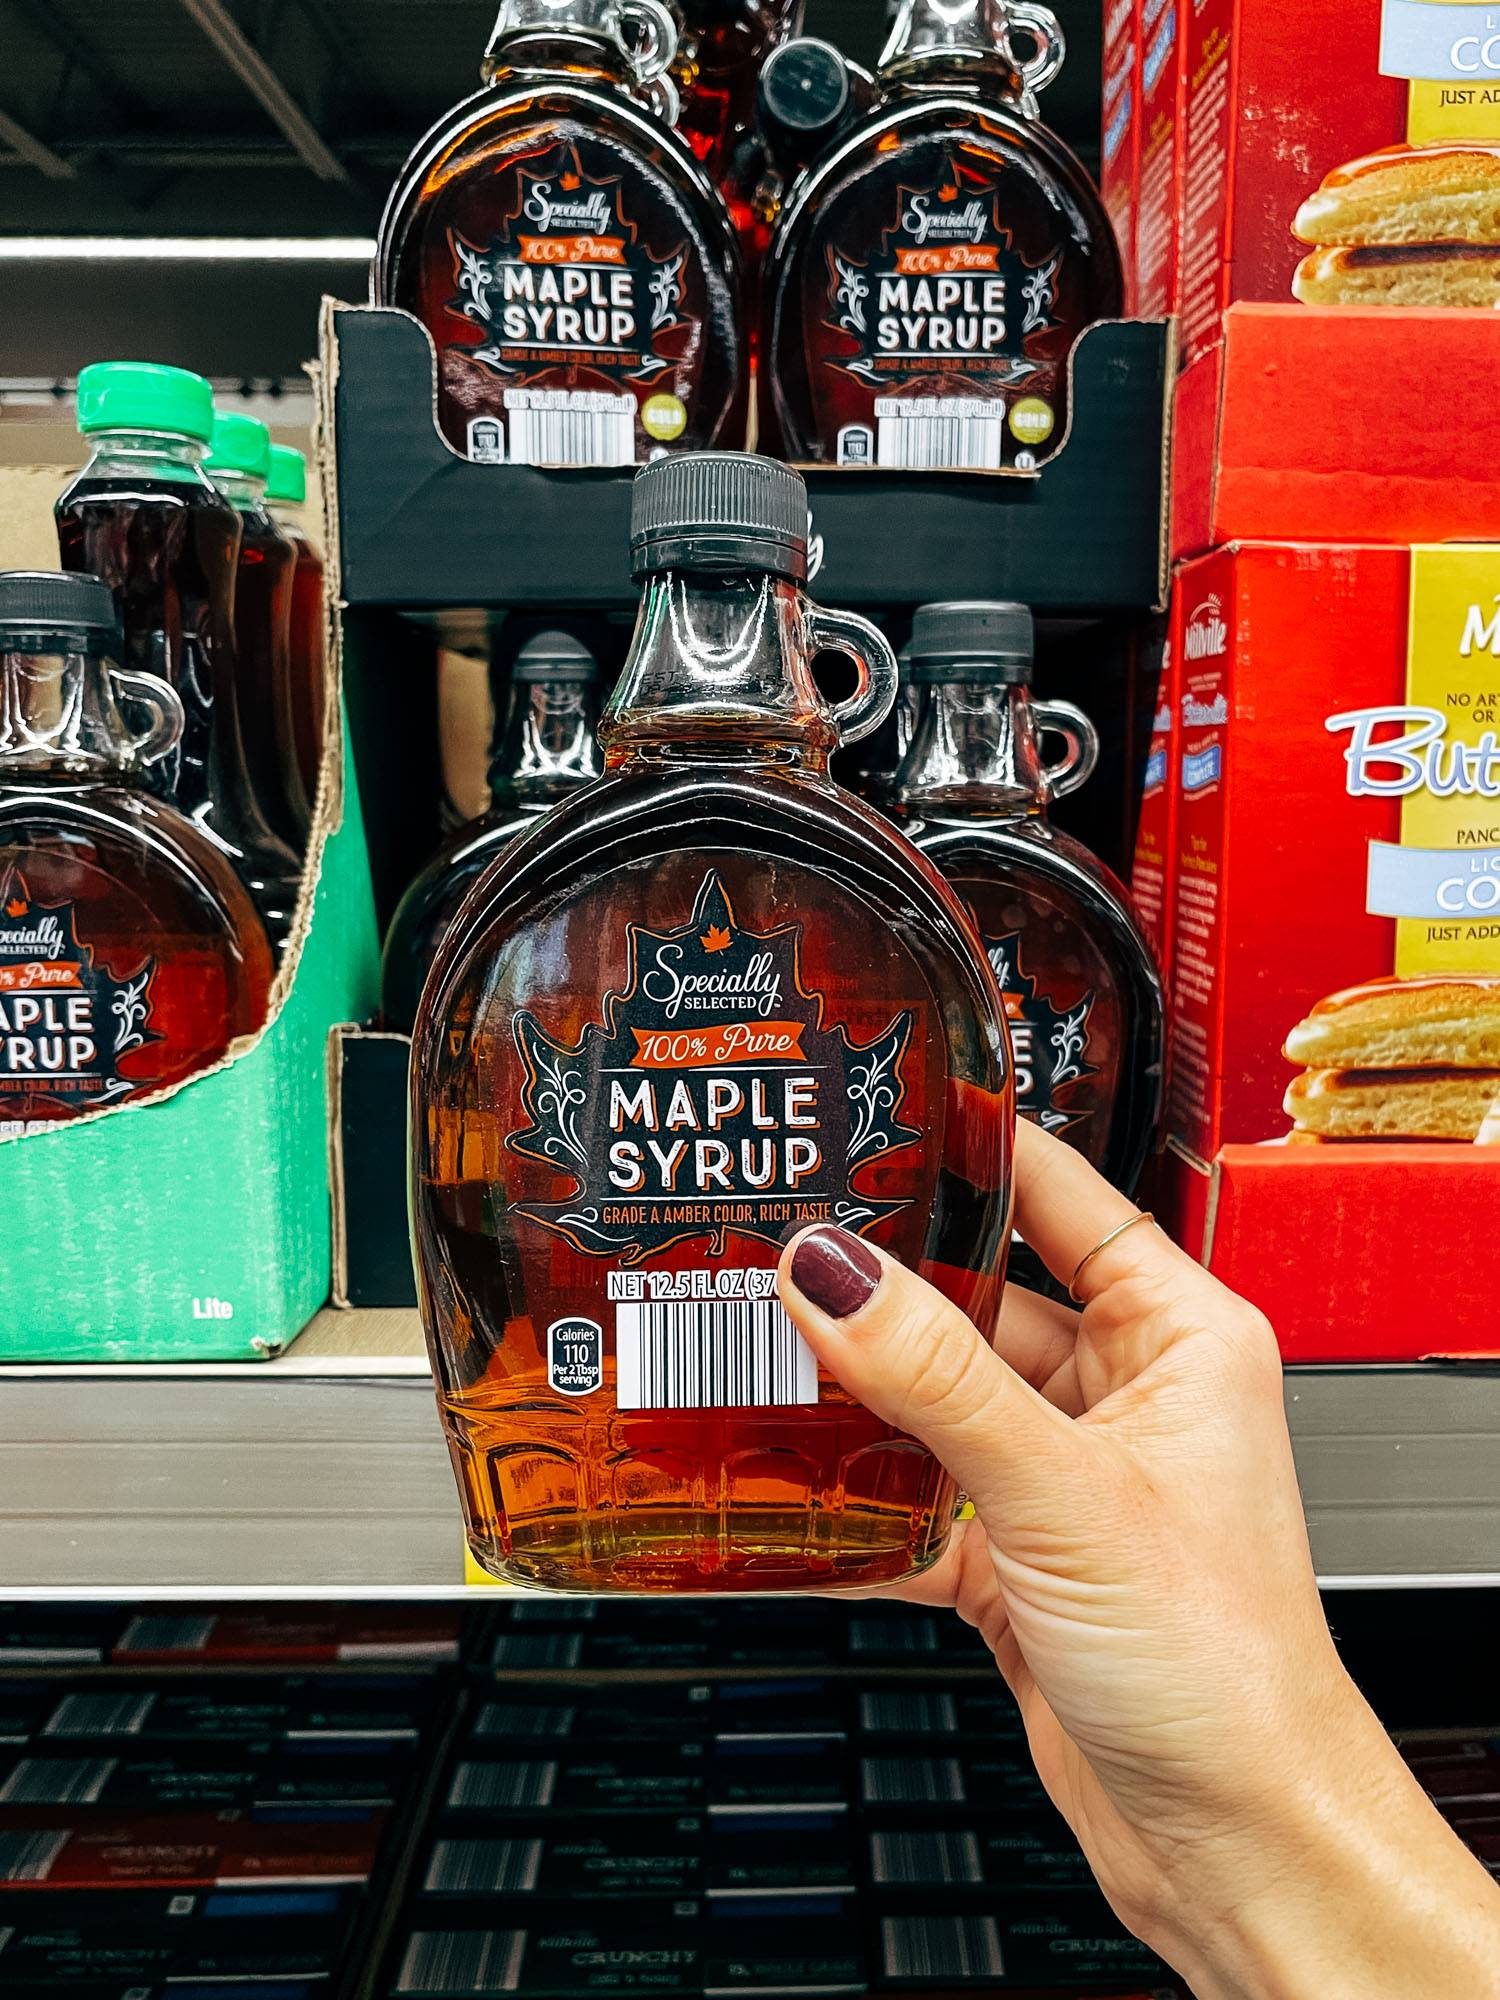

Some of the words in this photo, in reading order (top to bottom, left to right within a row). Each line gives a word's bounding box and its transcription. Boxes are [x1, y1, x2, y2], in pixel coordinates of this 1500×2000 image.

[1440, 89, 1476, 107] JUST
[524, 181, 611, 235] Specially
[902, 195, 988, 244] Specially
[569, 236, 619, 261] Pure
[943, 245, 992, 271] Pure
[503, 266, 635, 308] MAPLE
[878, 278, 1007, 314] MAPLE
[502, 304, 637, 345] SYRUP
[876, 315, 1007, 351] SYRUP
[1447, 692, 1471, 707] NO
[1476, 692, 1500, 707] AR
[1472, 709, 1496, 724] OR
[1435, 876, 1500, 912] CO
[1427, 926, 1462, 944] JUST
[1466, 924, 1500, 941] ADD
[20, 962, 73, 988] Pure
[643, 944, 783, 1019] Specially
[684, 996, 757, 1009] SELECTED
[642, 1034, 708, 1062] 100%
[714, 1023, 795, 1061] Pure
[609, 1077, 821, 1133] MAPLE
[608, 1137, 823, 1191] SYRUP
[602, 1206, 647, 1224] GRADE
[650, 1206, 660, 1224] A
[663, 1205, 711, 1223] AMBER
[713, 1204, 757, 1225] COLOR,
[759, 1203, 791, 1222] RICH
[793, 1202, 832, 1221] TASTE
[609, 1272, 645, 1298] NET
[648, 1271, 691, 1298] 12.5
[694, 1271, 717, 1297] FL
[718, 1271, 745, 1297] OZ
[192, 1296, 234, 1319] Lite
[556, 1328, 595, 1341] Calories
[563, 1344, 589, 1364] 110
[553, 1364, 568, 1375] Per
[569, 1364, 576, 1375] 2
[575, 1364, 599, 1377] Tbsp
[559, 1375, 592, 1387] serving
